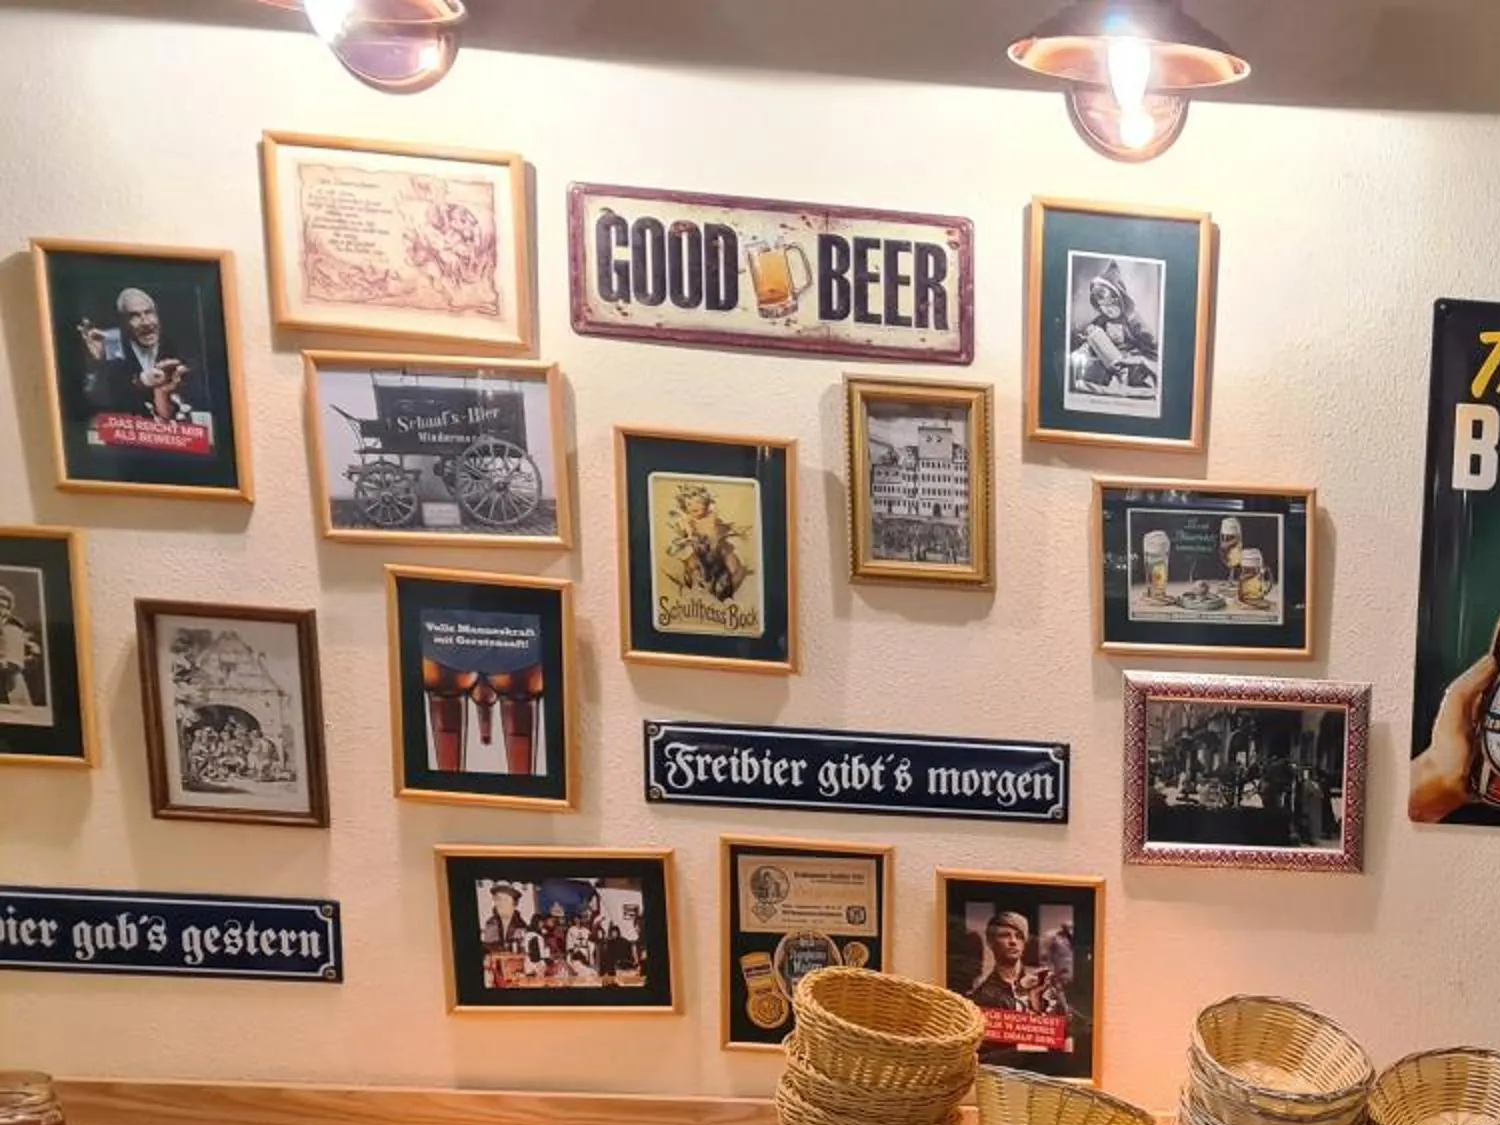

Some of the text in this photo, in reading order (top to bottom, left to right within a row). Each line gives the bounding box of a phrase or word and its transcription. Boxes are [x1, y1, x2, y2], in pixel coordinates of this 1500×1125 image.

[595, 208, 949, 331] GOOD BEER
[664, 740, 808, 790] Freibier
[927, 764, 1057, 807] morgen
[181, 918, 321, 966] gestern
